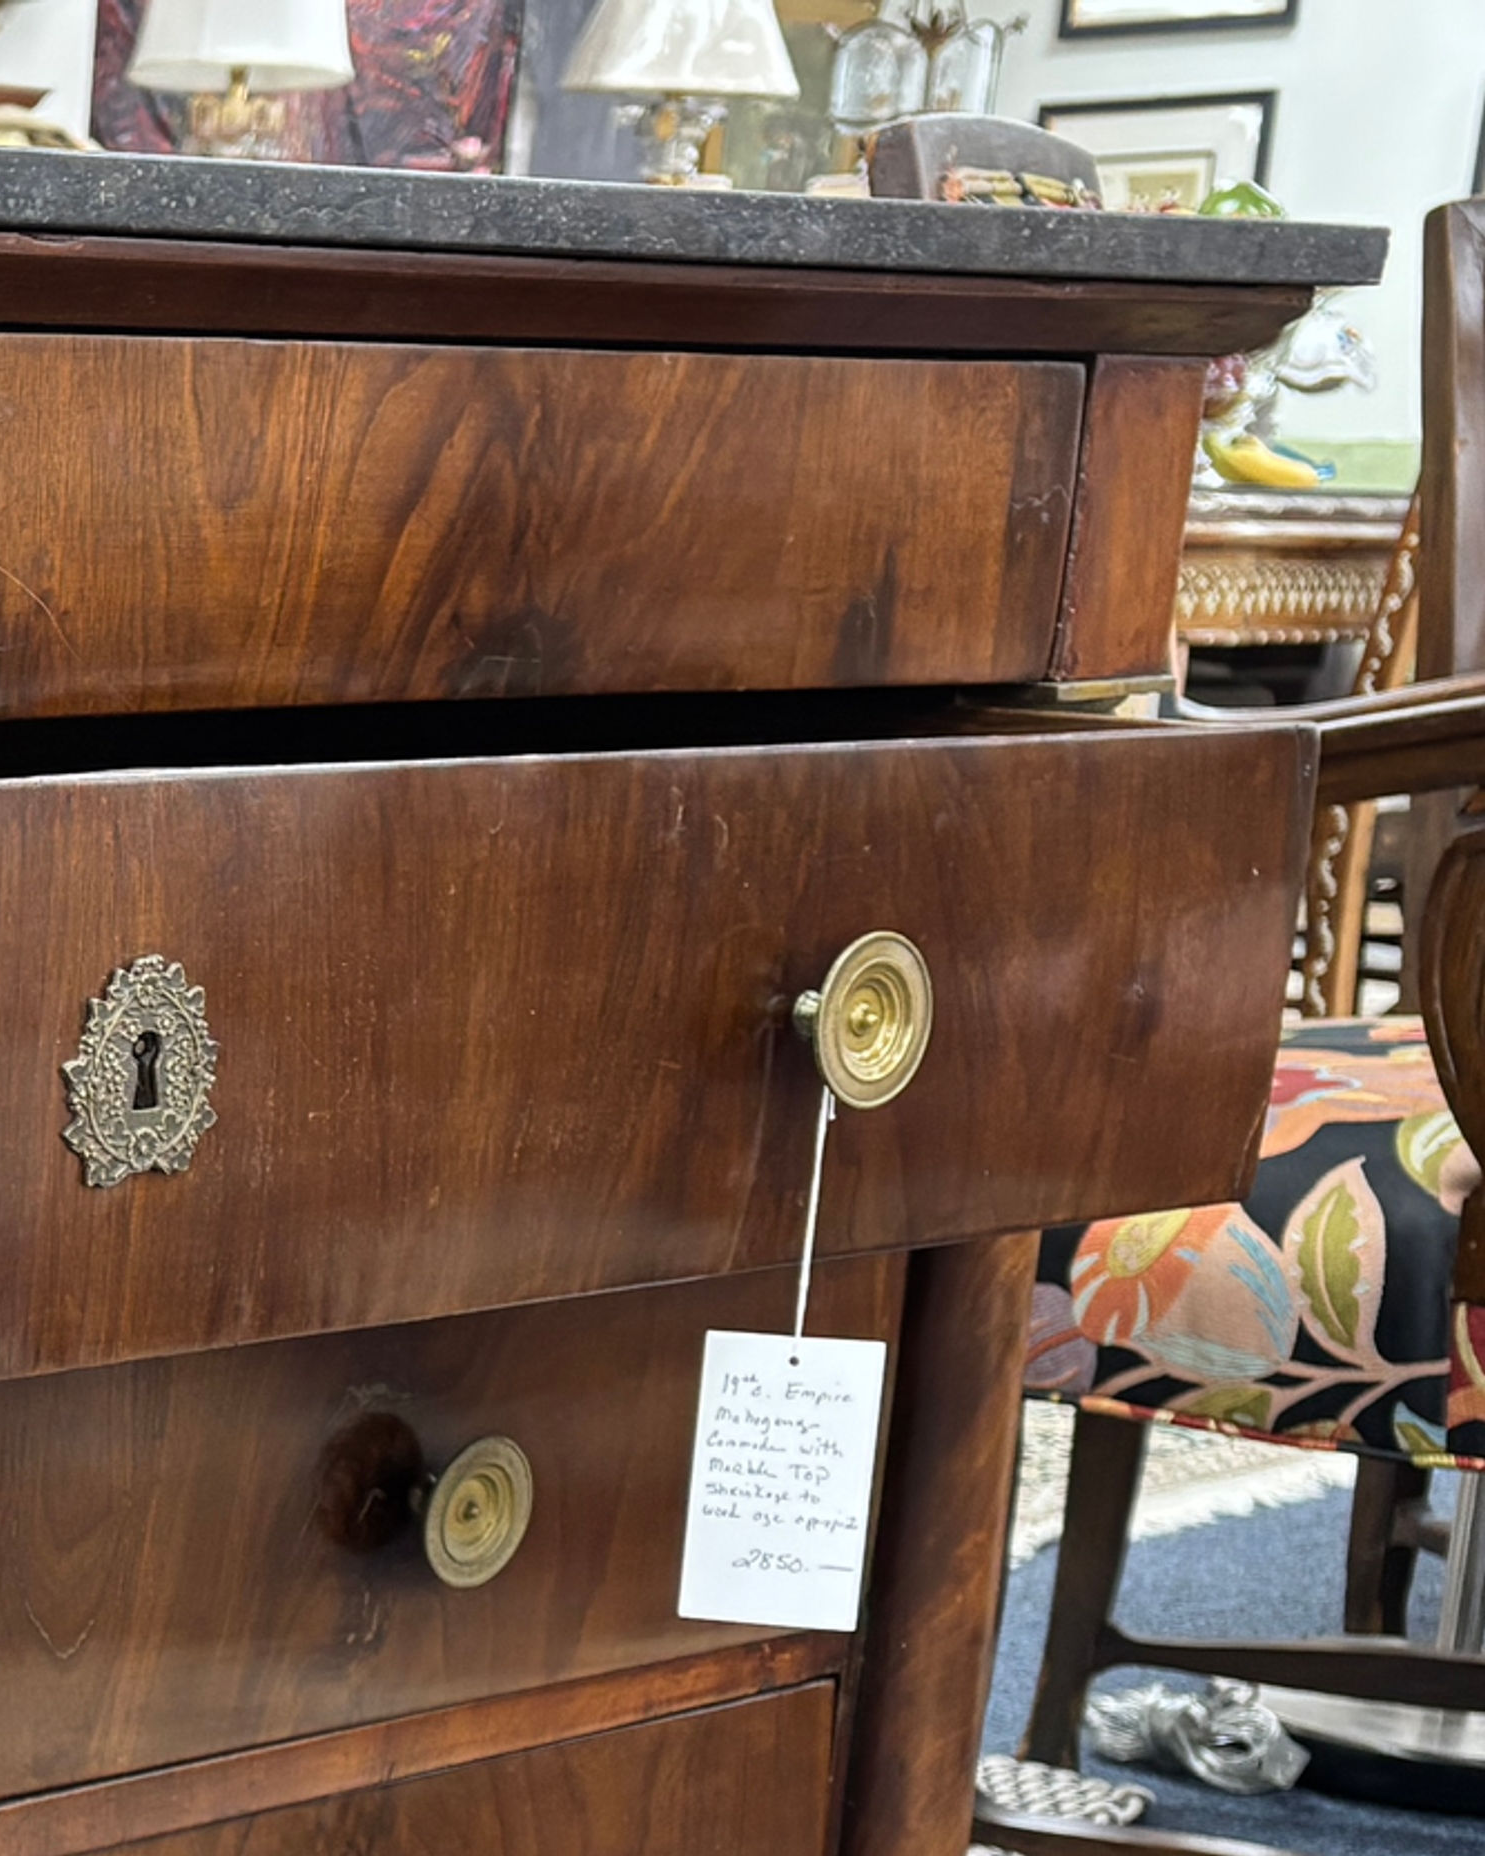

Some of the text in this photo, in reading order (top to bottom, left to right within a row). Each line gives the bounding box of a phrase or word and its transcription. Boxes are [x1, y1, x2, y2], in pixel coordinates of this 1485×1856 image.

[784, 1381, 853, 1405] Empire
[799, 1436, 844, 1458] with
[799, 1489, 821, 1505] to
